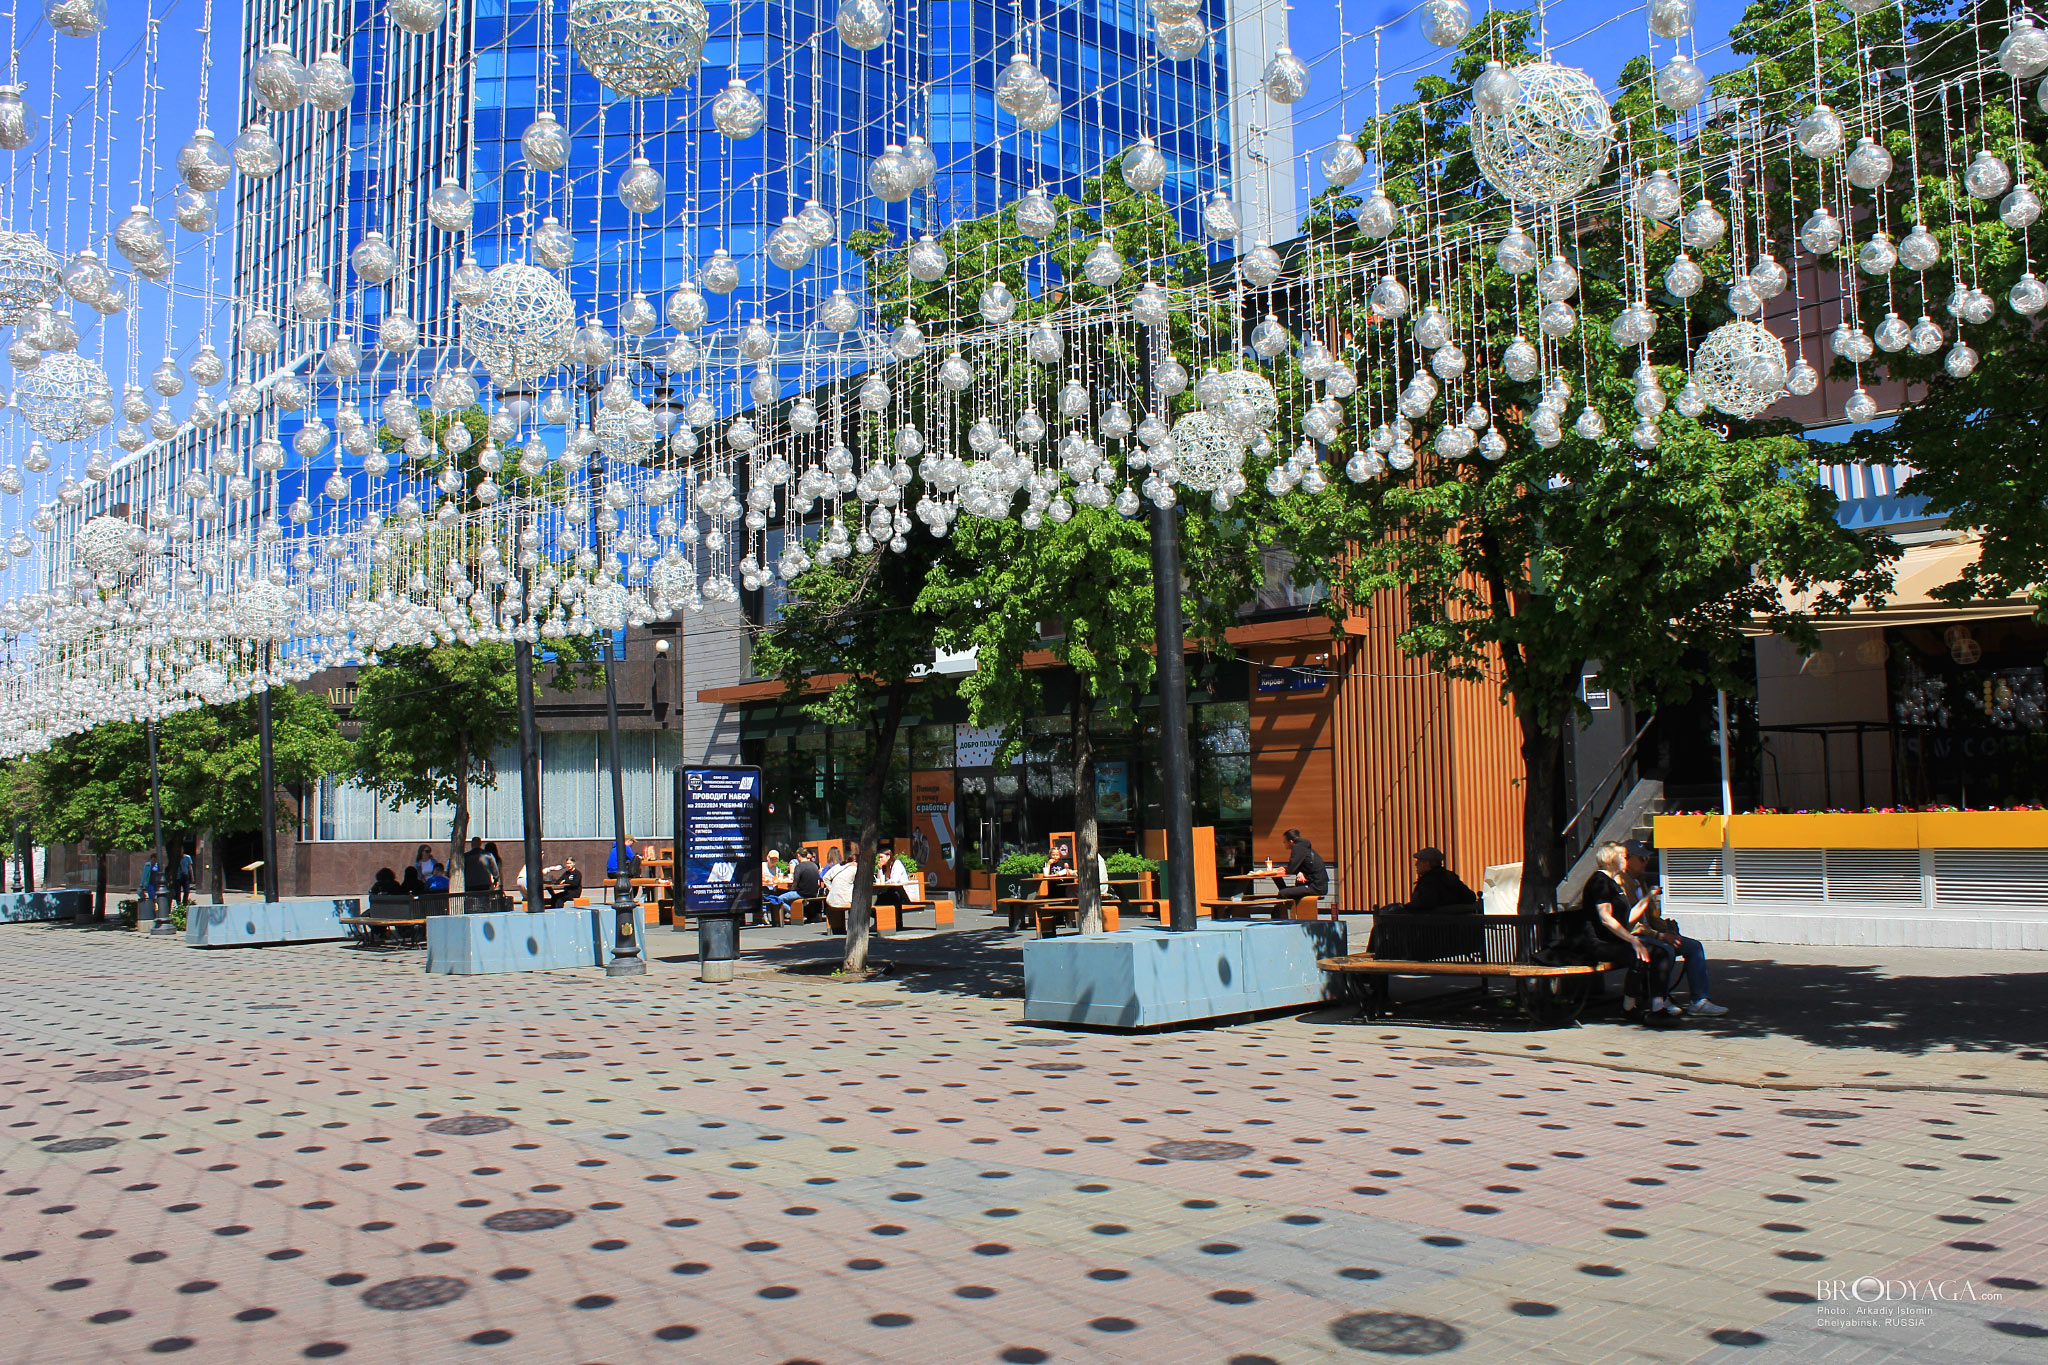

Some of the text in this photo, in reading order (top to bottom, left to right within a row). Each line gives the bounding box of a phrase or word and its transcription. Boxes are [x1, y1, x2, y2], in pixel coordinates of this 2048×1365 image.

[960, 739, 1007, 750] ДОБРО ПОЖАЛО
[692, 793, 728, 801] ПРОВОДИТ
[921, 803, 948, 813] работой
